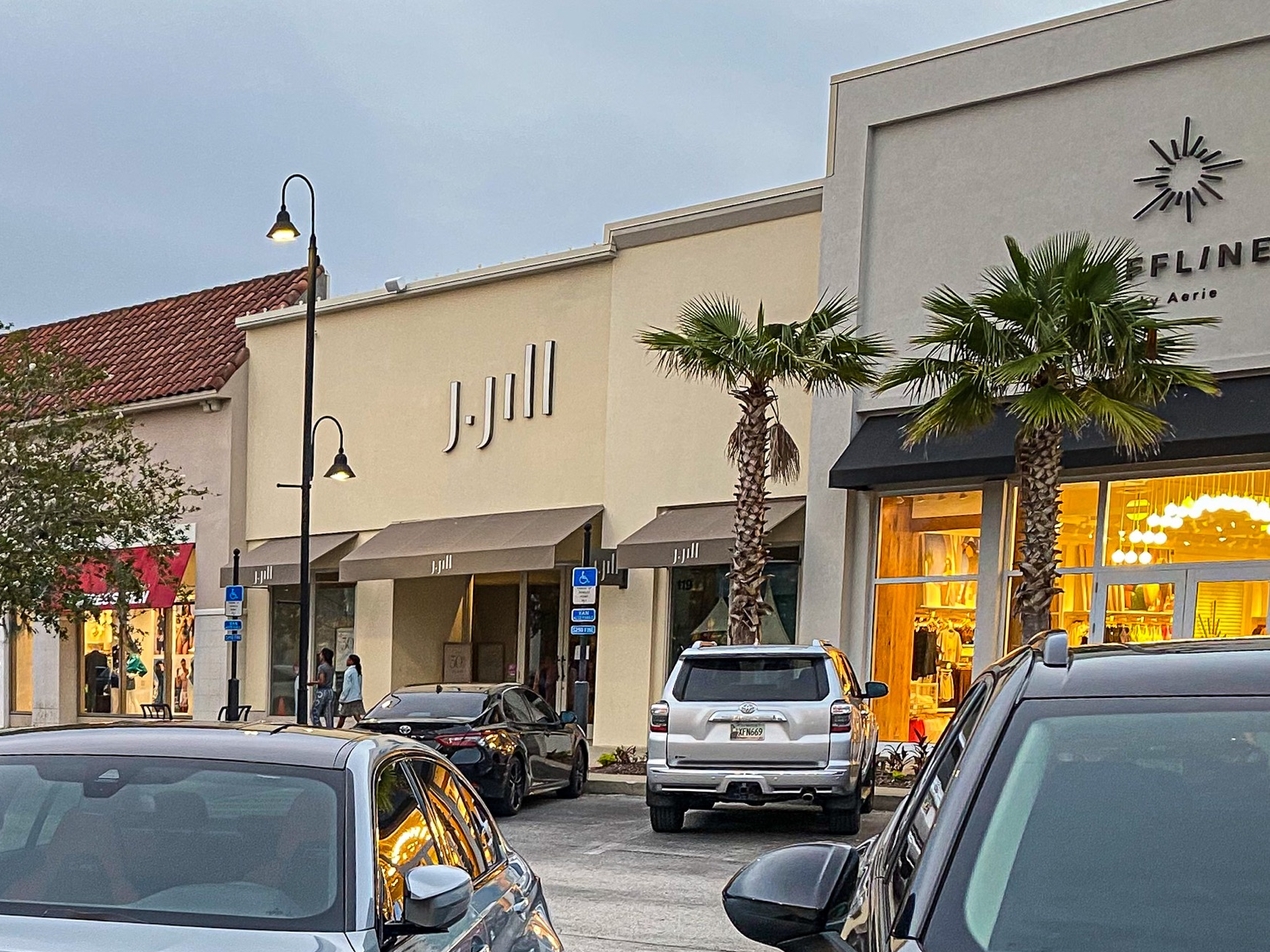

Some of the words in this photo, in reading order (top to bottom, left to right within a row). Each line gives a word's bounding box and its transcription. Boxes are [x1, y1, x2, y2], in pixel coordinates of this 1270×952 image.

[1126, 237, 1270, 281] FFLINE
[1167, 288, 1218, 304] Aerie
[738, 727, 764, 736] XFN669
